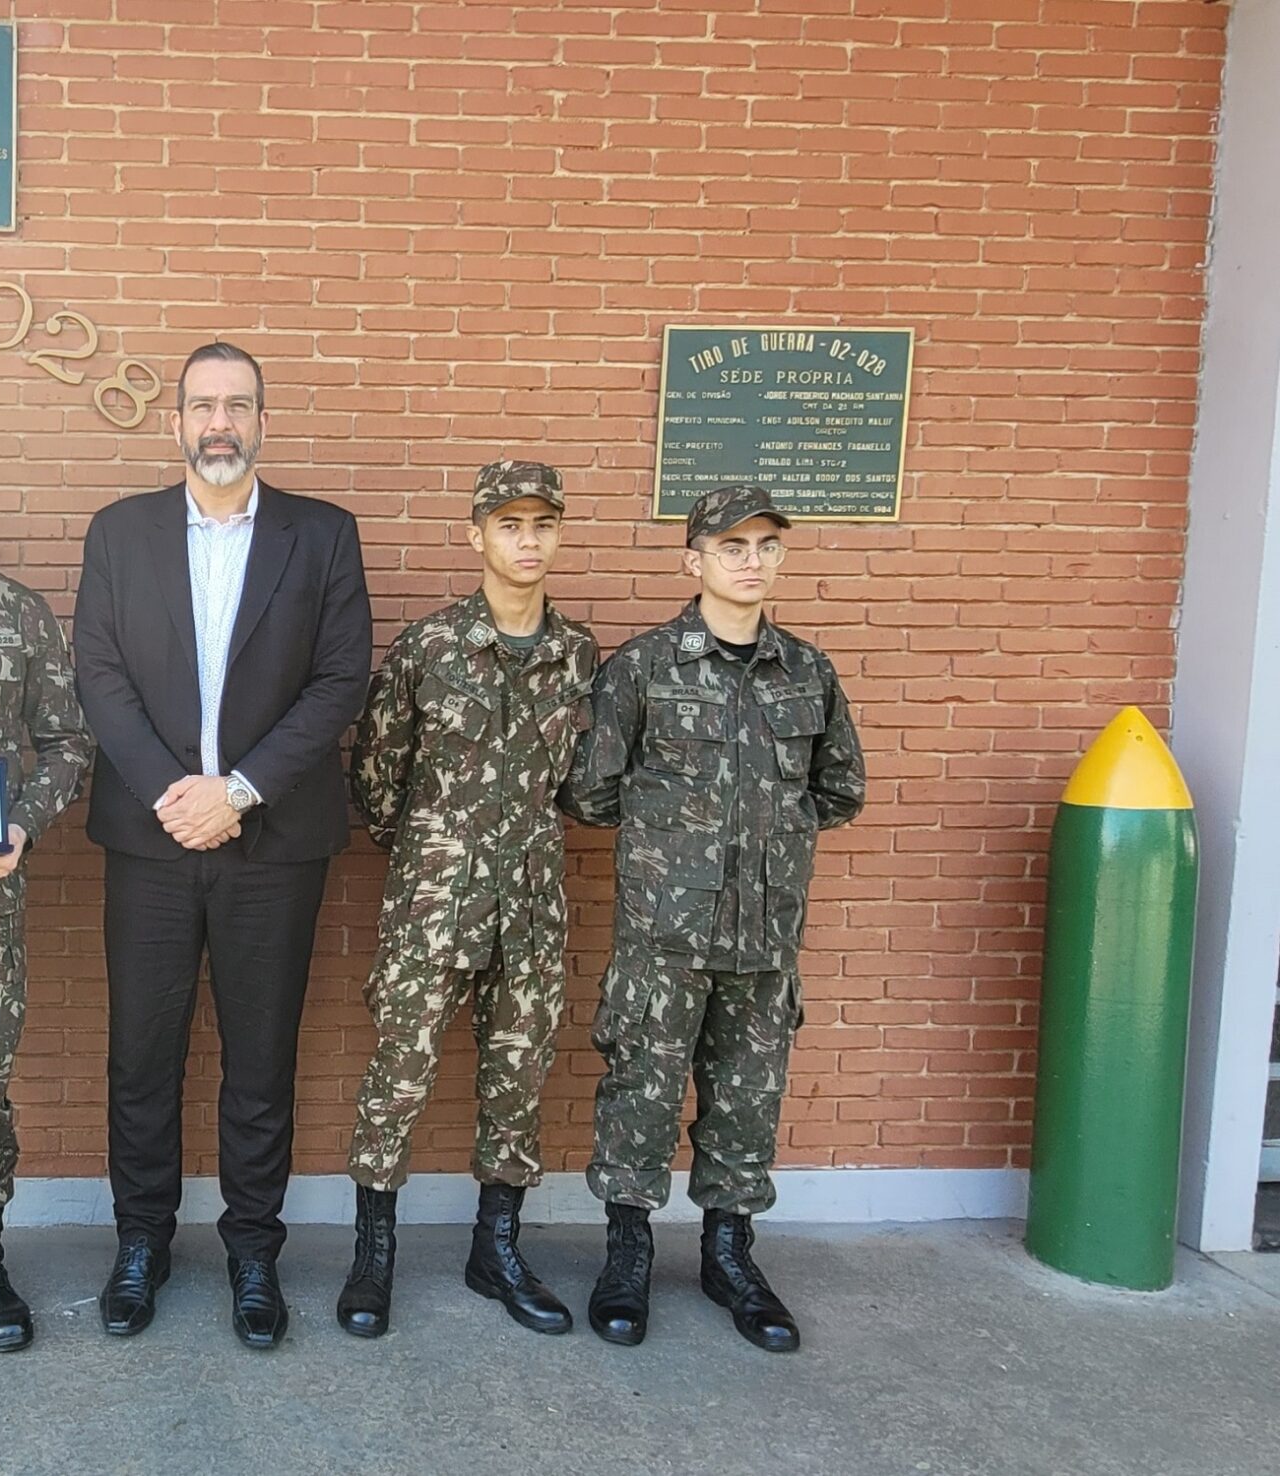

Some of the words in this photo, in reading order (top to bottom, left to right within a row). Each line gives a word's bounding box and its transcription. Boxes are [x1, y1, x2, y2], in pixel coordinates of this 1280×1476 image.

[688, 345, 724, 374] TIRO
[731, 337, 751, 358] DE
[760, 332, 815, 352] GUERRA
[776, 369, 853, 385] PRÓPRIA
[763, 391, 789, 400] JORGE
[789, 391, 830, 401] FREDERICO
[831, 391, 865, 401] MACHADO
[822, 402, 833, 410] DA
[665, 416, 702, 425] PREFEITO
[707, 417, 747, 425] MUNICIPAL
[786, 416, 820, 426] ADILSON
[825, 417, 864, 426] BENEDITO
[868, 417, 894, 426] MALUF
[760, 441, 794, 451] ANTONIO
[797, 441, 843, 451] FERNANDES
[663, 457, 697, 466] CORONEL
[845, 474, 862, 483] DOS
[865, 474, 897, 483] SANTOS
[680, 704, 695, 712] O+
